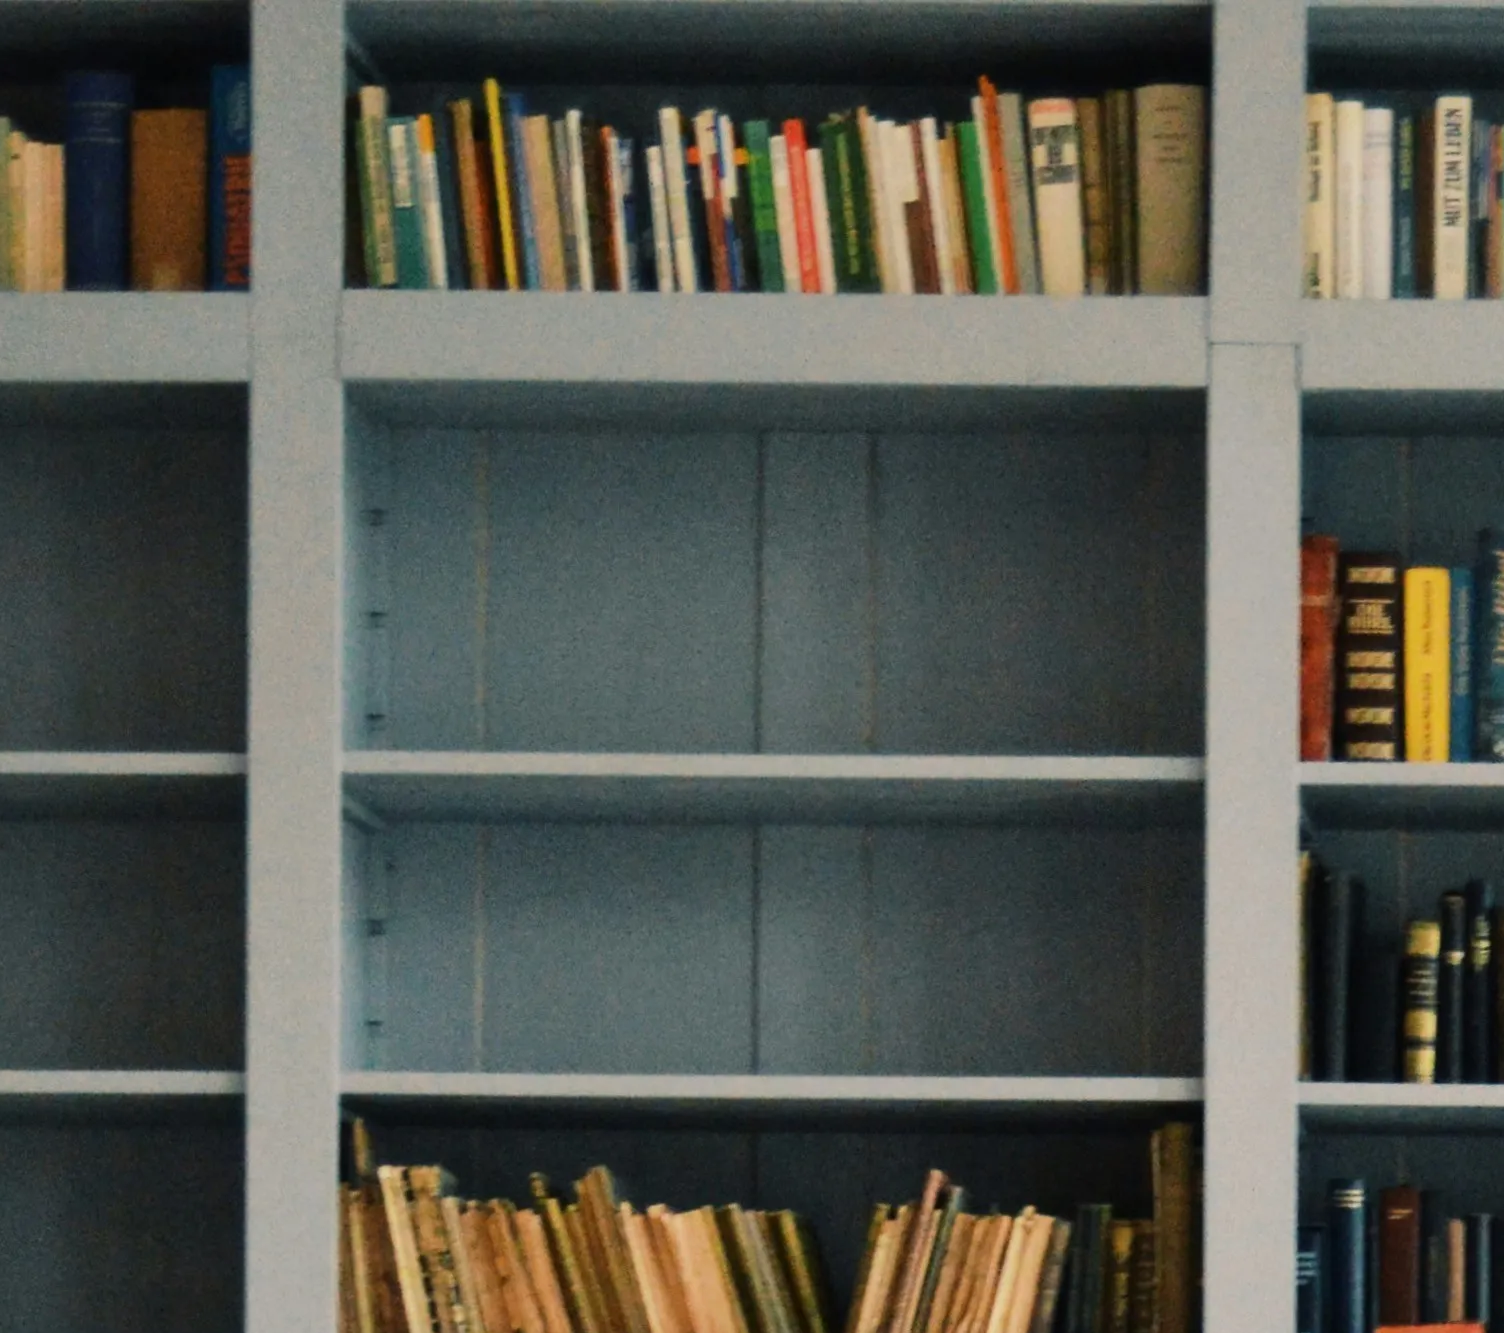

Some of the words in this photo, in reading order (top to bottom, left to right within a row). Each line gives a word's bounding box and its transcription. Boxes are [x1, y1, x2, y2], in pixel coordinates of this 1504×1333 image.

[1442, 107, 1461, 156] LEBEN
[1442, 160, 1461, 190] ZUM
[1442, 197, 1461, 226] MUT
